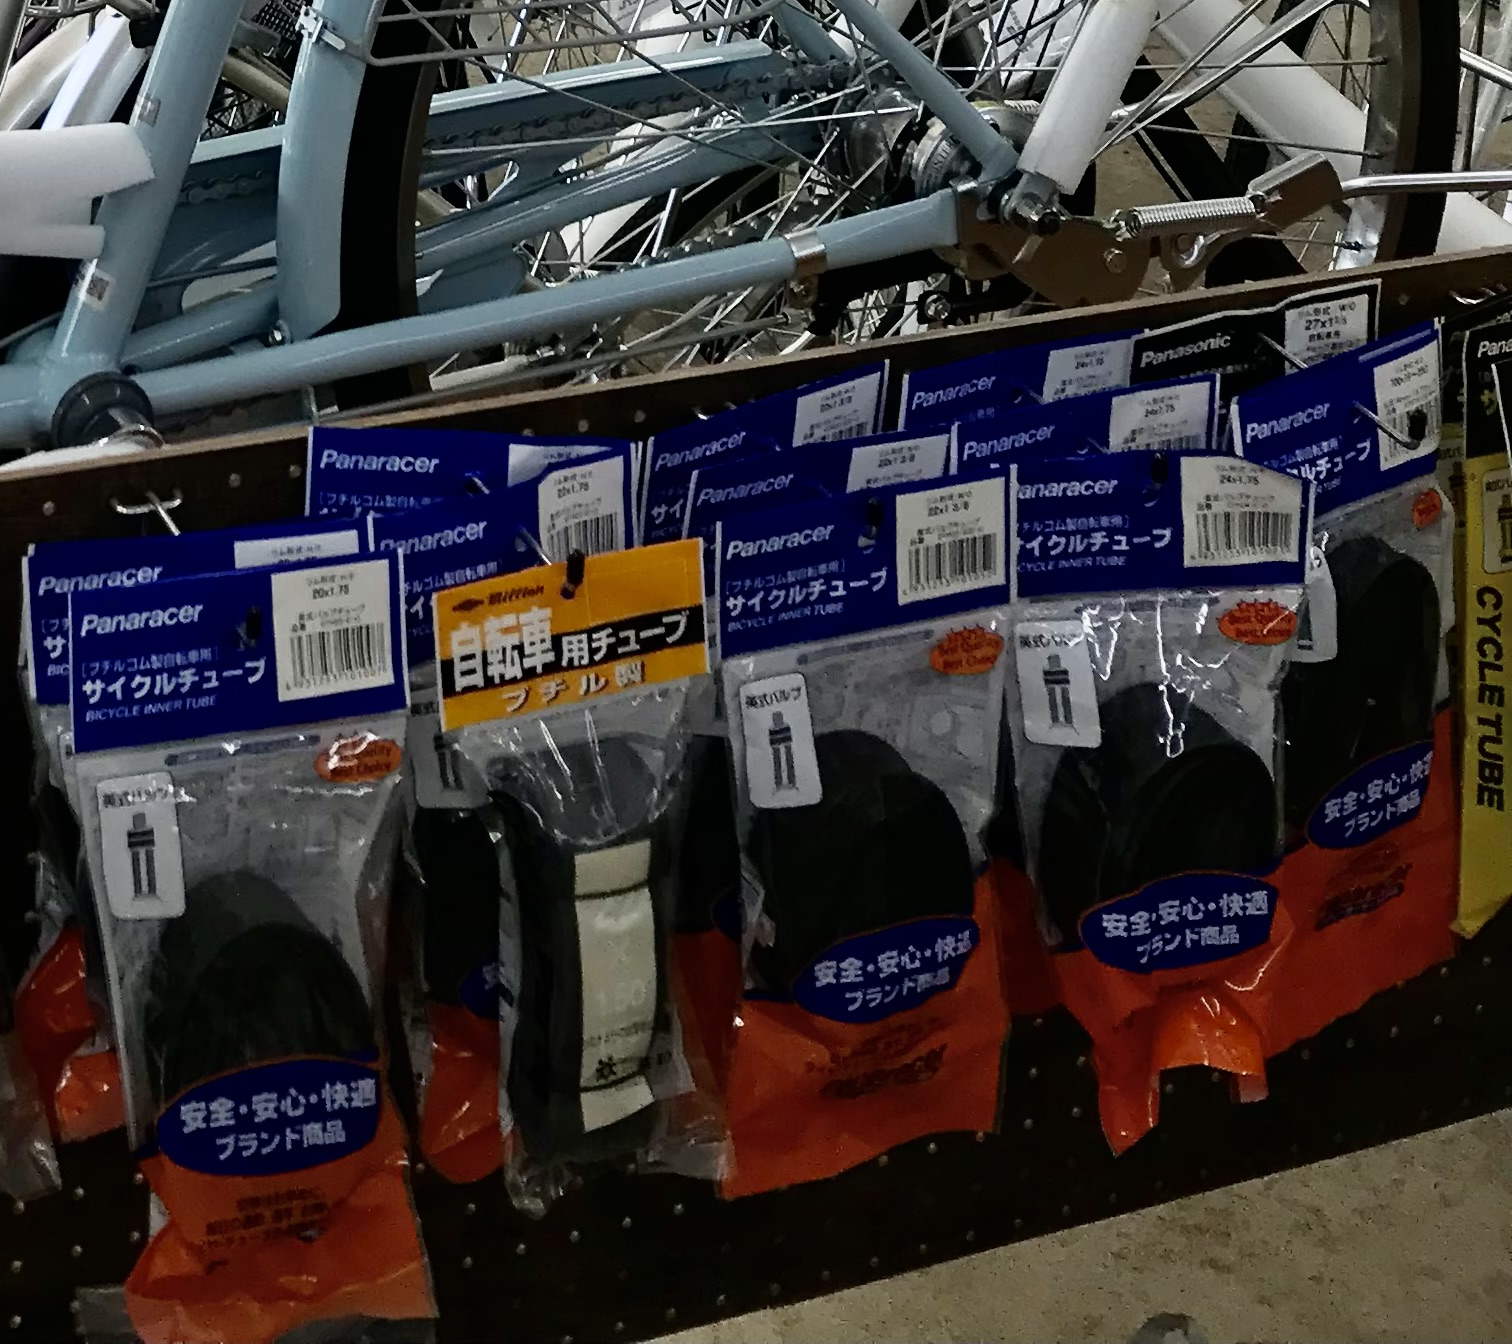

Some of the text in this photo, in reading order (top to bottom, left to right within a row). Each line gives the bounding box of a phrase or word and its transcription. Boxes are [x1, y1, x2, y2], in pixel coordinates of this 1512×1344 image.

[1140, 332, 1231, 368] Panasonic
[911, 374, 996, 410] Panaracer
[1246, 402, 1330, 443] Panaracer
[655, 430, 746, 471] Panaracer
[962, 424, 1056, 461] Panaracer
[320, 449, 439, 473] Panaracer
[697, 473, 794, 506] Panaracer
[1017, 478, 1118, 500] anaracer
[726, 525, 835, 561] Panaracer
[38, 565, 163, 597] Panaracer
[726, 566, 889, 616] サイクルチューブ
[80, 602, 204, 638] Panaracer
[728, 614, 775, 633] BICYCLE
[451, 606, 689, 693] 自転車用チューブ
[82, 657, 268, 705] サイクルチューブ
[85, 693, 218, 723] BICYCLE INNER TUBE
[1101, 890, 1269, 939] 安全・安心・快適
[1136, 924, 1241, 964] ブランド商品
[179, 1077, 377, 1134] 安全・安心・快適
[215, 1118, 347, 1161] ブランド商品
